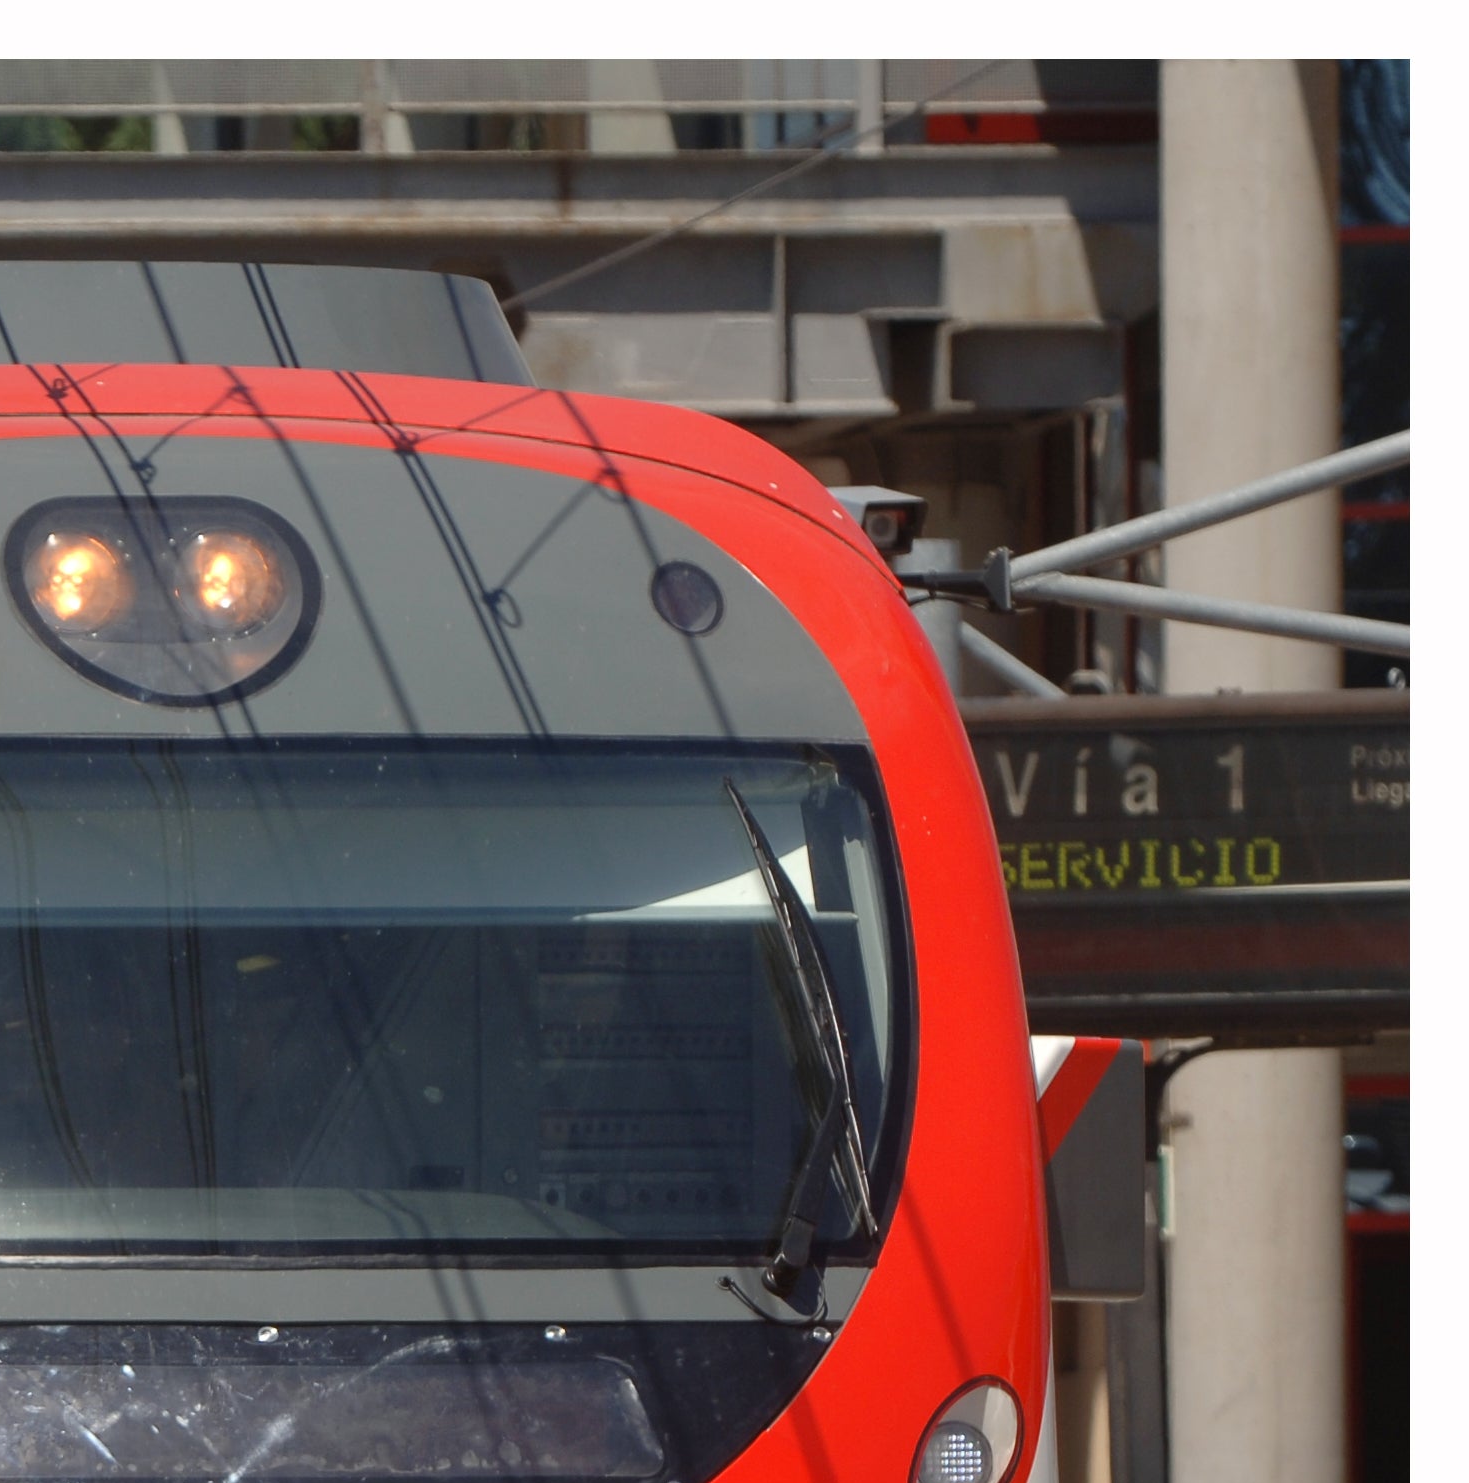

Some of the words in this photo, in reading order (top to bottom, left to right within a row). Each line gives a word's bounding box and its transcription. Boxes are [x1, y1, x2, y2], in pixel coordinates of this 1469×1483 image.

[997, 748, 1160, 817] Vía
[1217, 743, 1246, 812] 1
[1350, 743, 1409, 768] Próx
